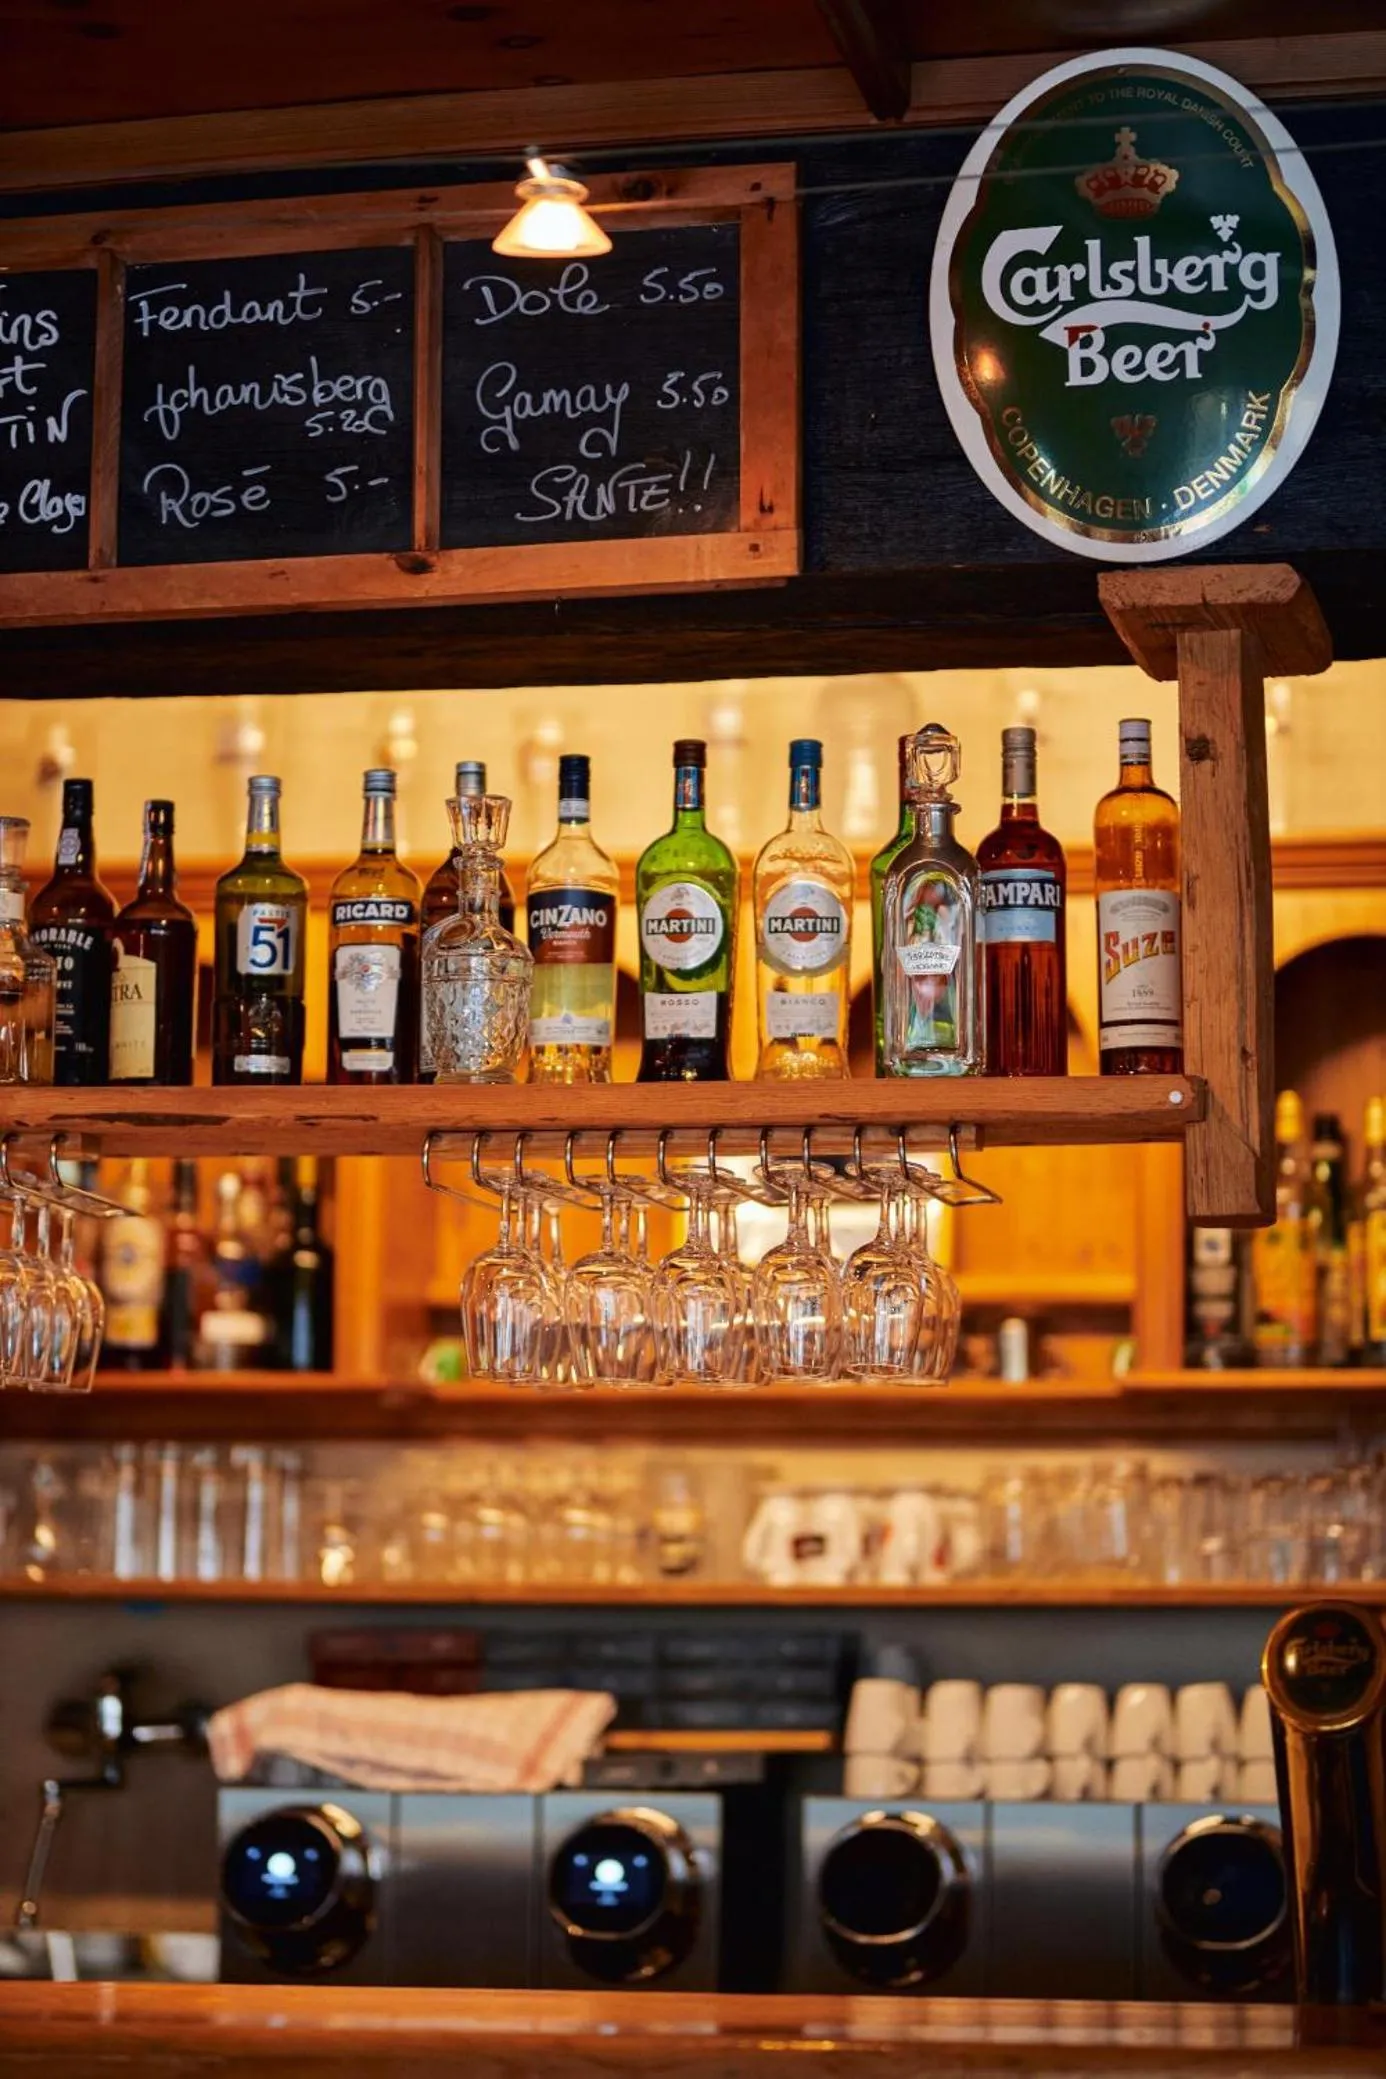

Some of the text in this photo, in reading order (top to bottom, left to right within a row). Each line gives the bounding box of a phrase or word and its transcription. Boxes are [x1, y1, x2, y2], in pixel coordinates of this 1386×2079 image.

[1109, 86, 1133, 99] THE
[1136, 86, 1179, 105] ROYAL
[1181, 98, 1225, 132] DANISH
[1222, 128, 1254, 169] COURT
[640, 267, 724, 303] 5.50
[981, 225, 1281, 328] Carlsberg
[129, 274, 327, 336] Fendant
[1064, 322, 1217, 387] Beer
[476, 362, 629, 459] Gamay
[1002, 390, 1270, 520] COPENHAGEN DENMARK
[336, 903, 408, 920] RICARD
[530, 904, 607, 928] CINZANO
[648, 919, 713, 933] MARTINI
[771, 918, 838, 932] MARTINI
[249, 925, 290, 970] 51
